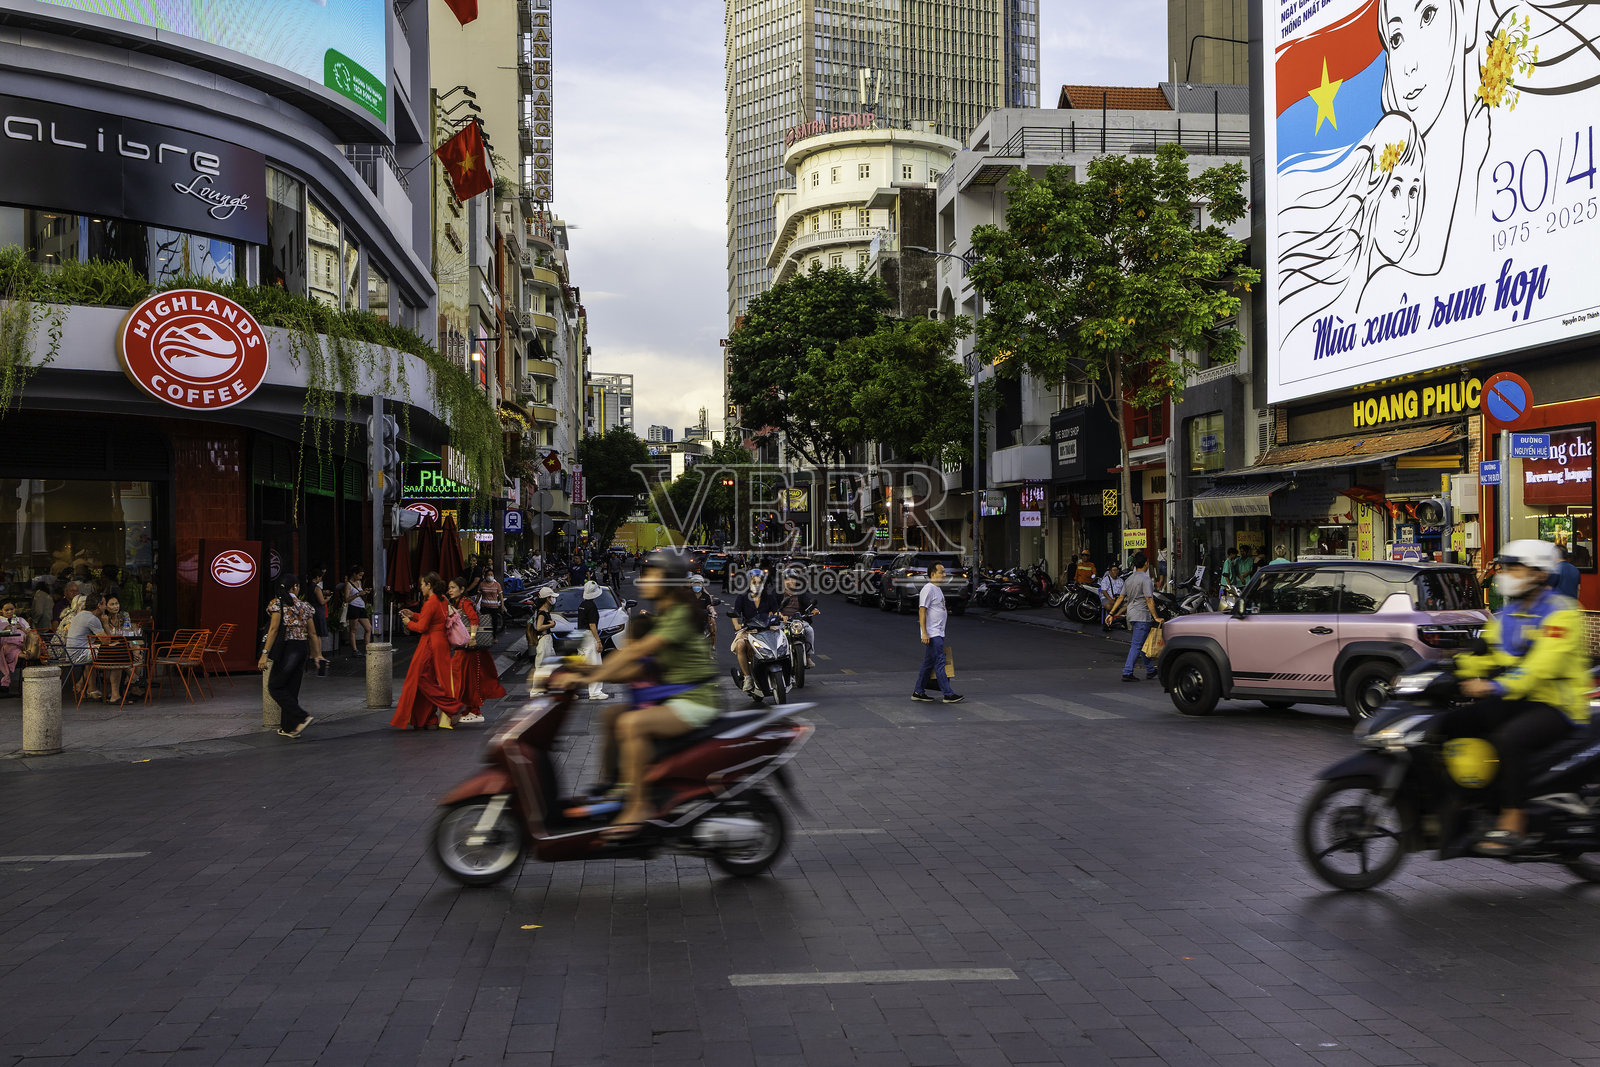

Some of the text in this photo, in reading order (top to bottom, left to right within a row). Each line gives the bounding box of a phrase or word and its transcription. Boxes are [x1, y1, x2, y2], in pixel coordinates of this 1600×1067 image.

[1280, 4, 1297, 23] NGÀY
[1281, 1, 1320, 39] THỐNG NHẤT
[795, 113, 875, 139] SATRA GROUP
[1491, 125, 1597, 222] 30/4
[175, 174, 250, 220] Lounge
[1492, 223, 1530, 252] 1975
[1546, 198, 1598, 234] 2025
[133, 294, 260, 348] HIGHLANDS
[1312, 258, 1551, 360] Mùa xuân sum họp
[151, 374, 248, 404] COFFEE
[1353, 389, 1418, 427] HOANG
[1514, 445, 1536, 455] NGUYỄN
[1525, 470, 1564, 484] Brewing
[1360, 504, 1370, 518] 97
